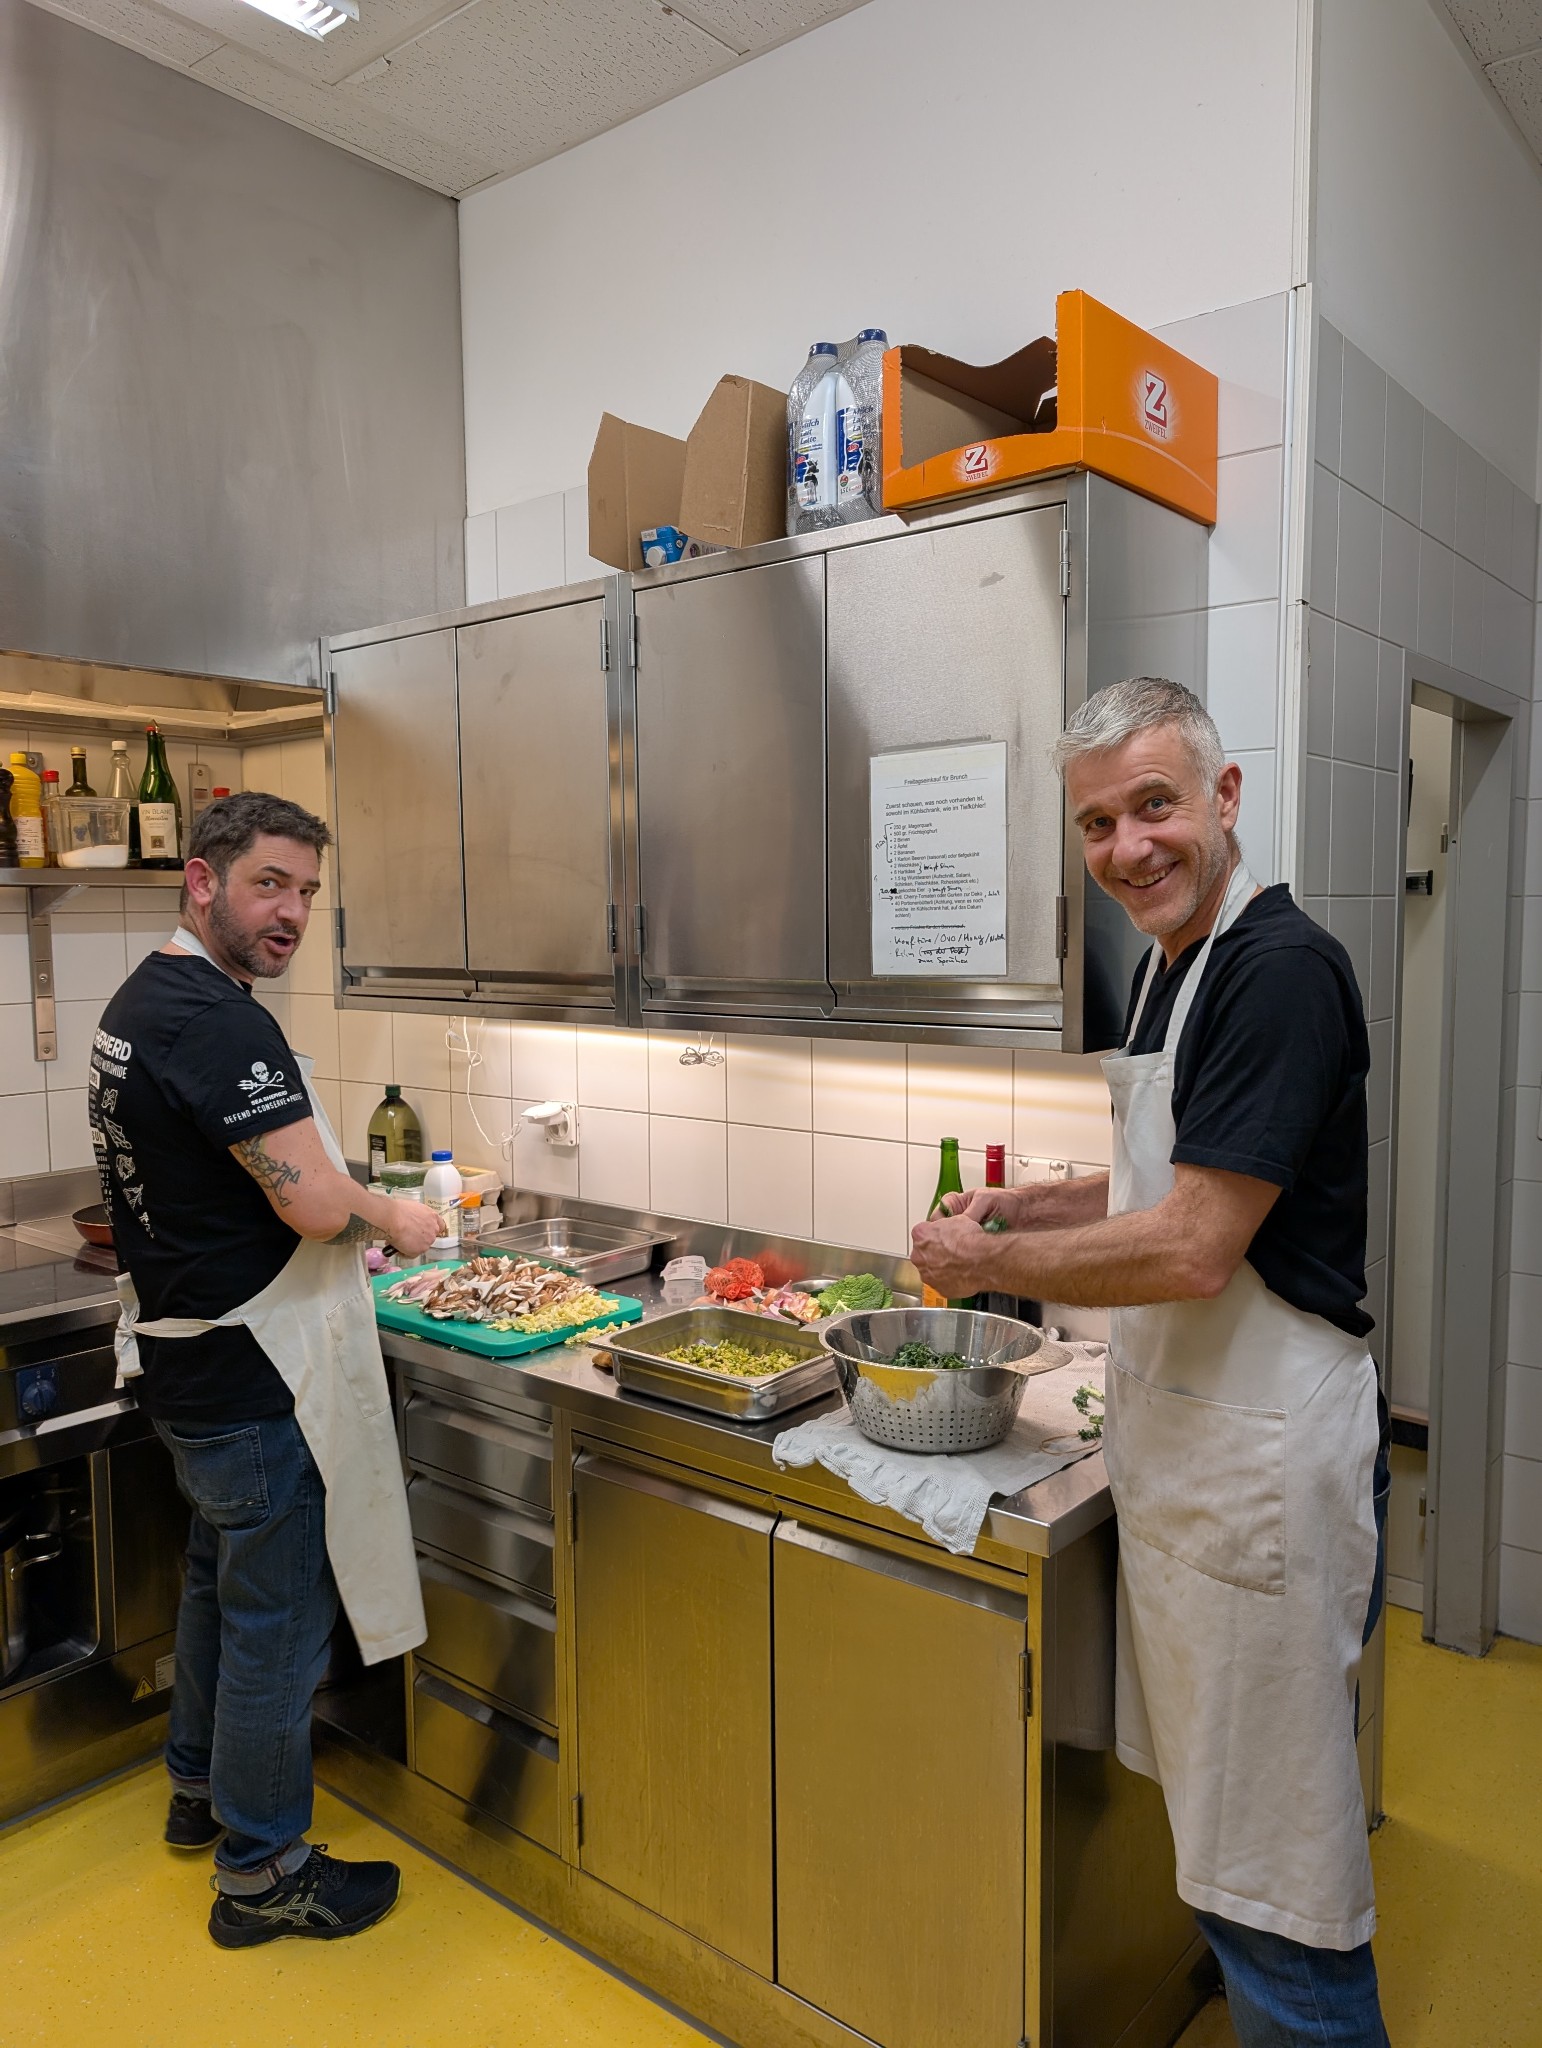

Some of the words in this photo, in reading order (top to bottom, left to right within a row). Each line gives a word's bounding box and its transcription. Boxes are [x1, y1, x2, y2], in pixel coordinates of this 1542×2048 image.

[1145, 420, 1168, 440] ZWEIFEL
[949, 796, 976, 804] vorhanden
[251, 1098, 263, 1106] SEA
[263, 1090, 288, 1102] SHEPHERD
[224, 1110, 252, 1124] DEFEND
[256, 1098, 288, 1114] CONSERVE
